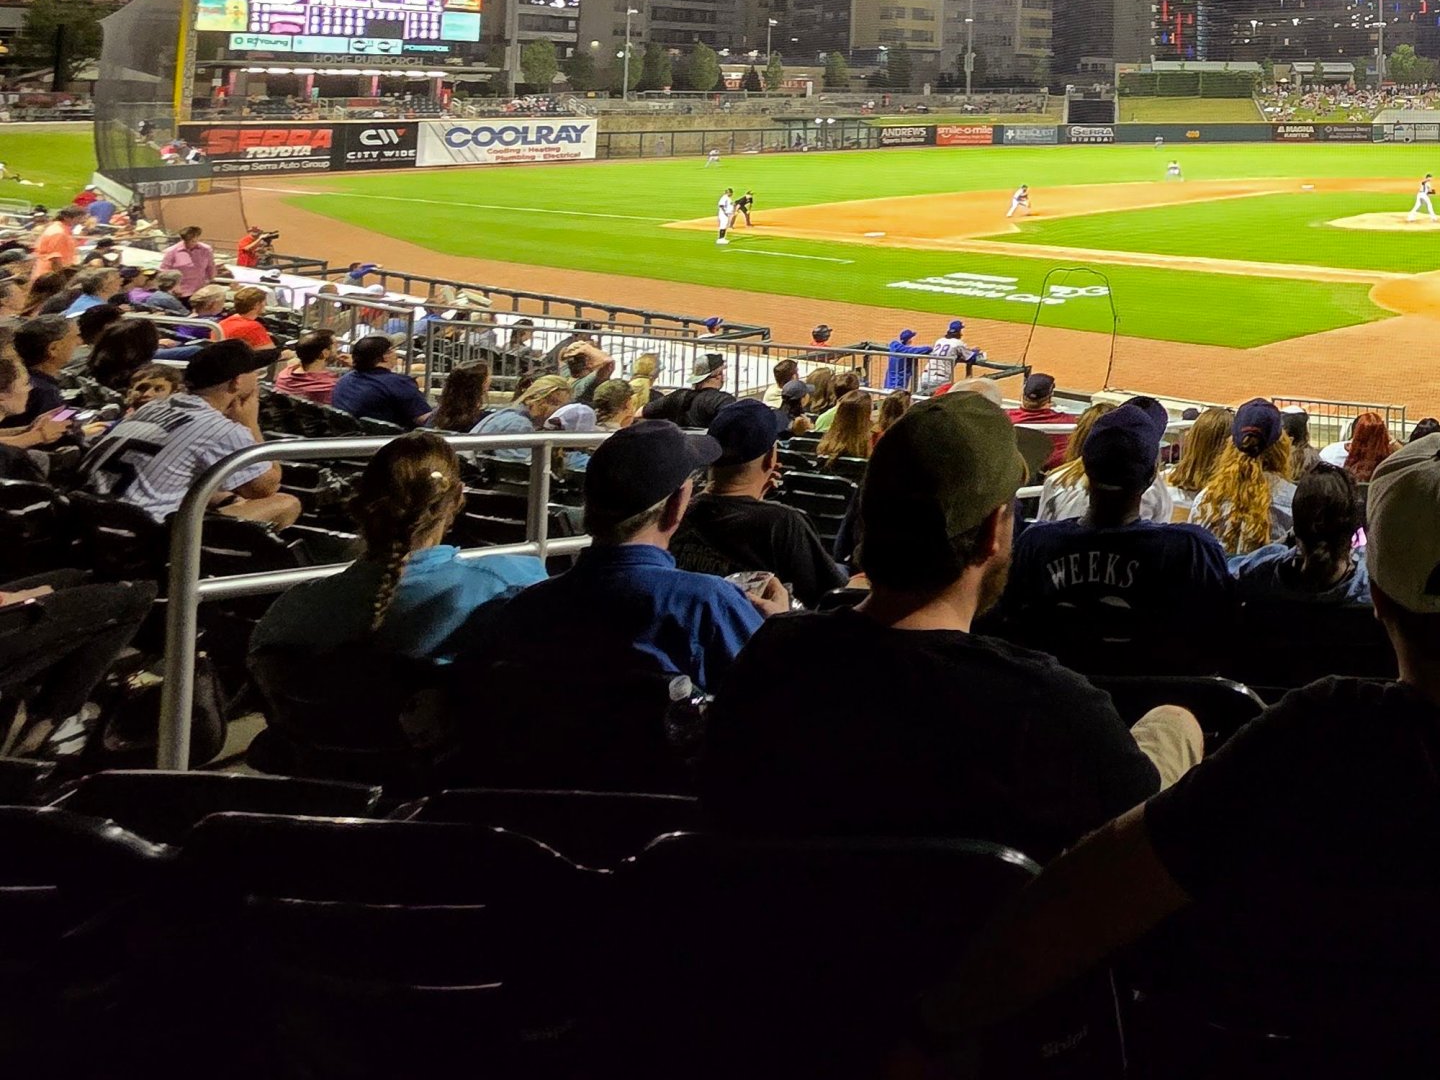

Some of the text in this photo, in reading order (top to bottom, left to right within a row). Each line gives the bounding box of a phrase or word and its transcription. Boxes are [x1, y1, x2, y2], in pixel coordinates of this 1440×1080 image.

[314, 54, 350, 64] HOME
[380, 56, 424, 66] PORCH
[881, 127, 926, 137] ANDREWS
[937, 125, 992, 135] smile-o-mile
[200, 128, 333, 155] SERRA
[445, 124, 591, 149] COOLRAY
[245, 145, 312, 158] TOYOTA
[346, 149, 416, 160] CITY WIDE
[487, 147, 521, 155] Cooling
[495, 152, 581, 162] Plumbing Electrical
[222, 163, 250, 172] Steve
[251, 162, 278, 171] Serra
[279, 160, 300, 170] Auto
[301, 160, 330, 171] Group
[1046, 550, 1140, 590] WEEKS
